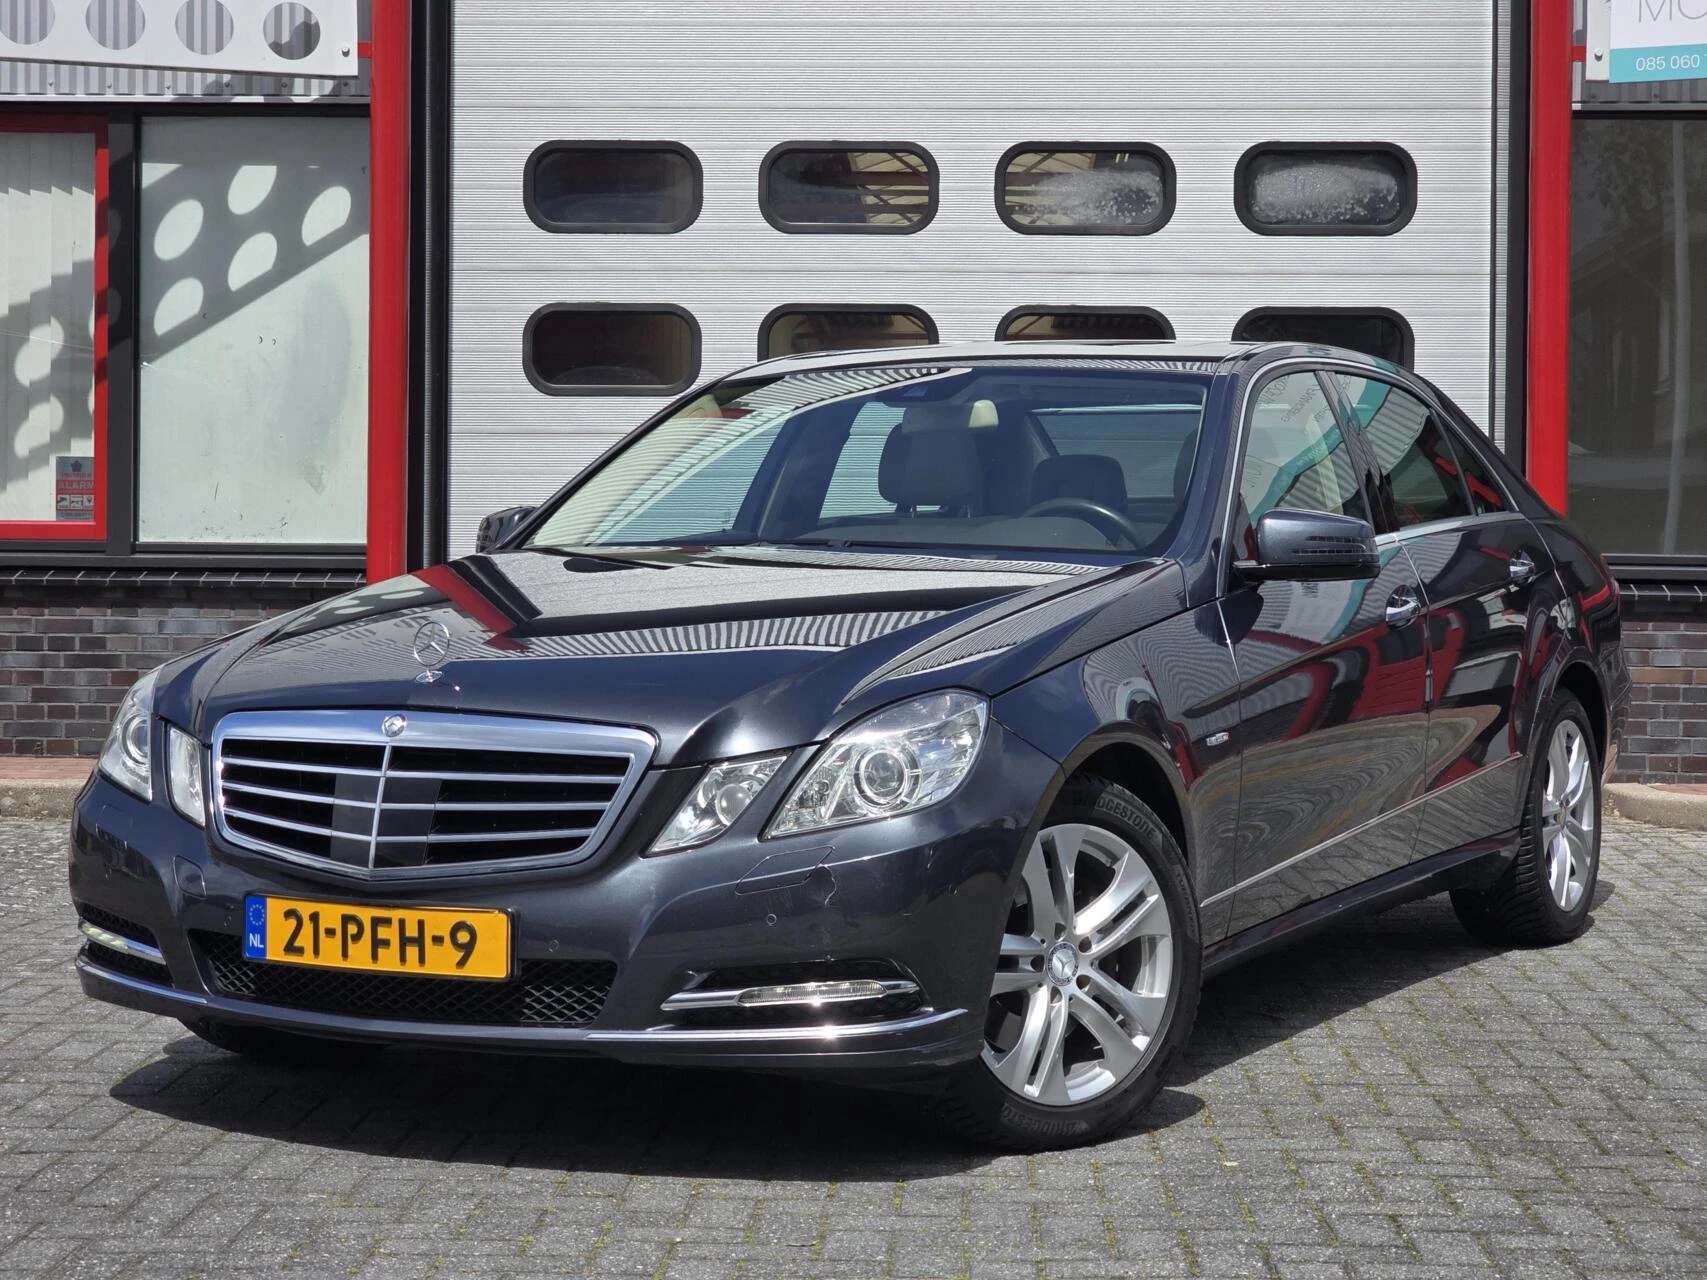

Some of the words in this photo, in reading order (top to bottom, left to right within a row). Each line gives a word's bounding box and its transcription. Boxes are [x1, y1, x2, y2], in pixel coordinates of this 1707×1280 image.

[1635, 56, 1666, 71] 085
[1670, 54, 1700, 69] 060
[249, 933, 264, 949] NL
[283, 907, 478, 969] 21-PFH-9
